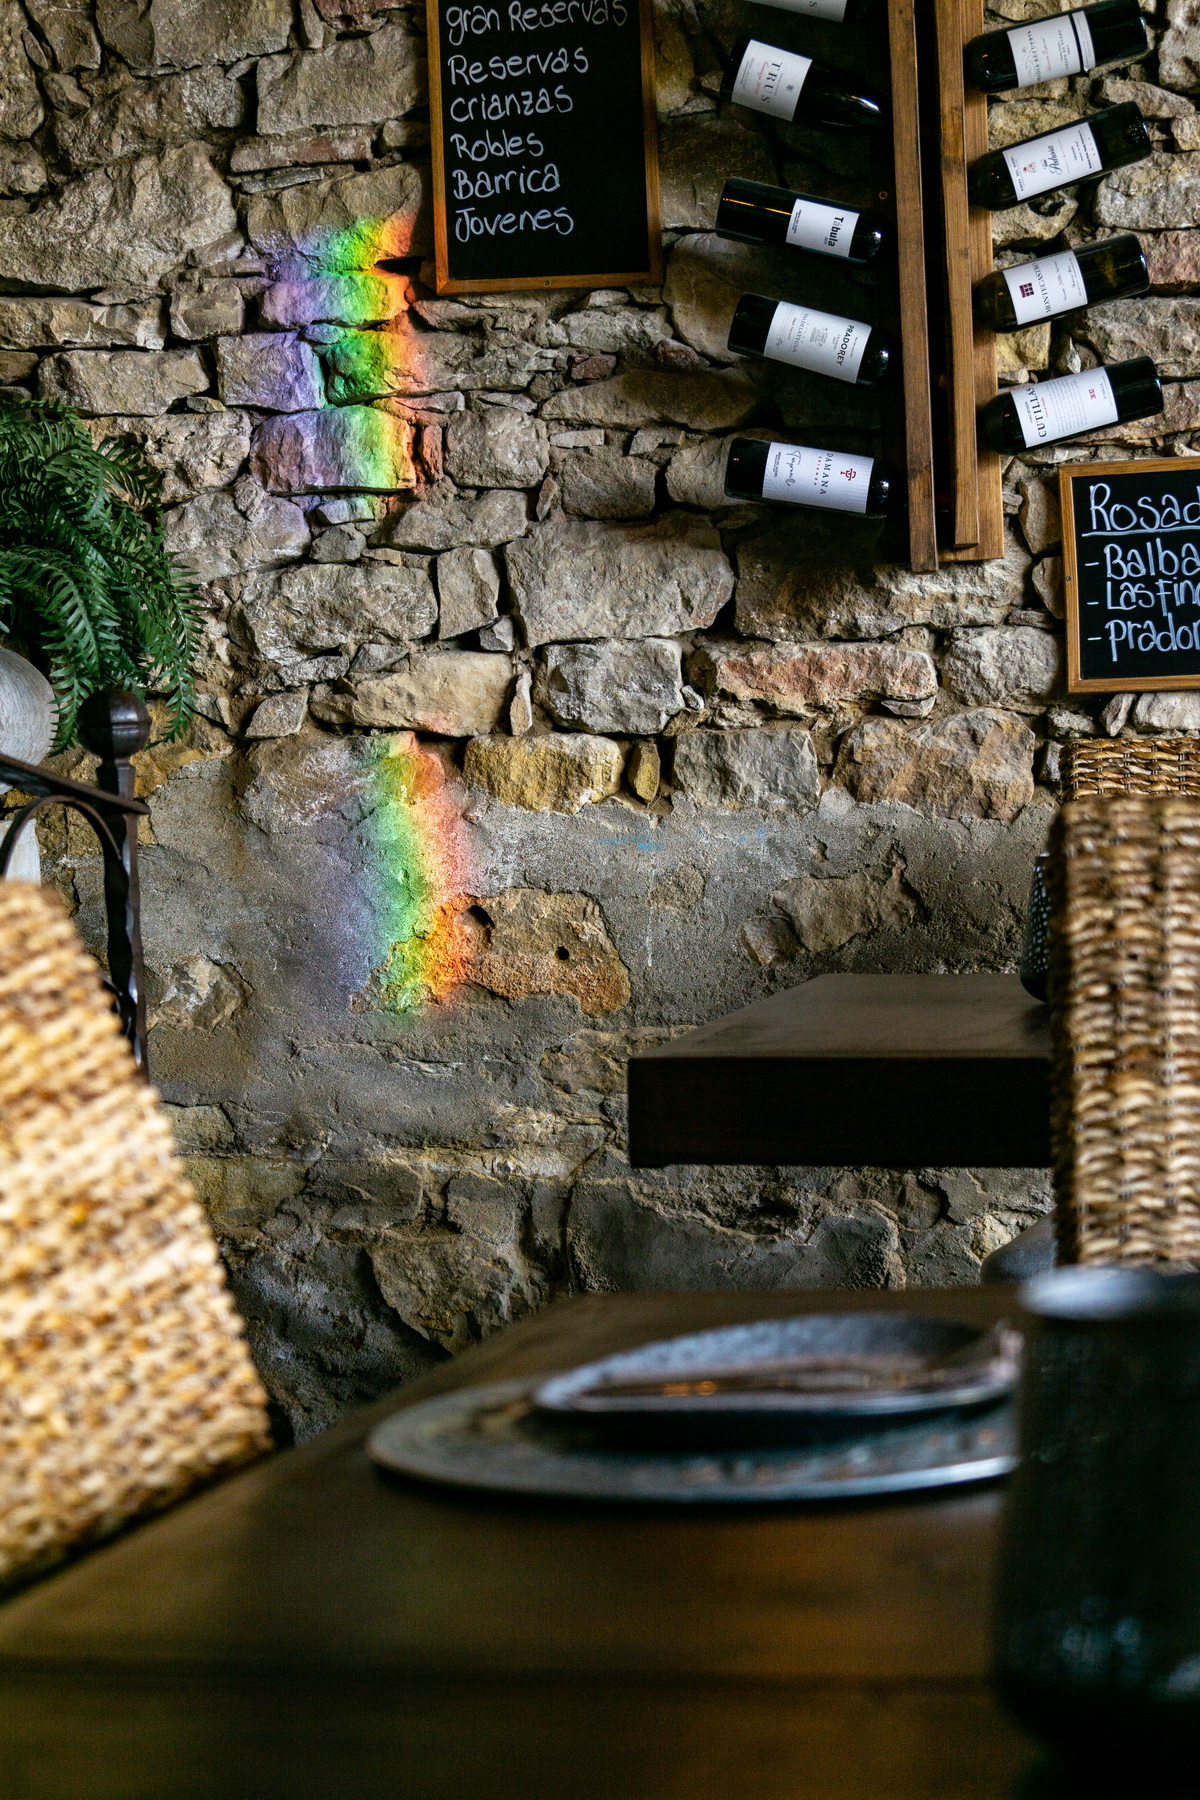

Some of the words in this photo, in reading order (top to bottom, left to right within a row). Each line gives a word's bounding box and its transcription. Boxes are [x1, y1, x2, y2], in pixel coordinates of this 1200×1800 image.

[446, 5, 500, 46] gran
[508, 0, 628, 32] Reservas
[448, 47, 589, 86] Reservas
[760, 60, 783, 104] TRUS
[450, 85, 573, 122] crianzas
[450, 129, 544, 162] Robles
[452, 163, 560, 200] Barrica
[455, 206, 574, 242] Jovenes
[1032, 262, 1052, 313] MONTECASTRO
[835, 324, 855, 366] PRADOREY
[1026, 386, 1048, 438] CUTILLAS
[820, 452, 834, 496] DAMANA
[1104, 537, 1200, 580] Balba
